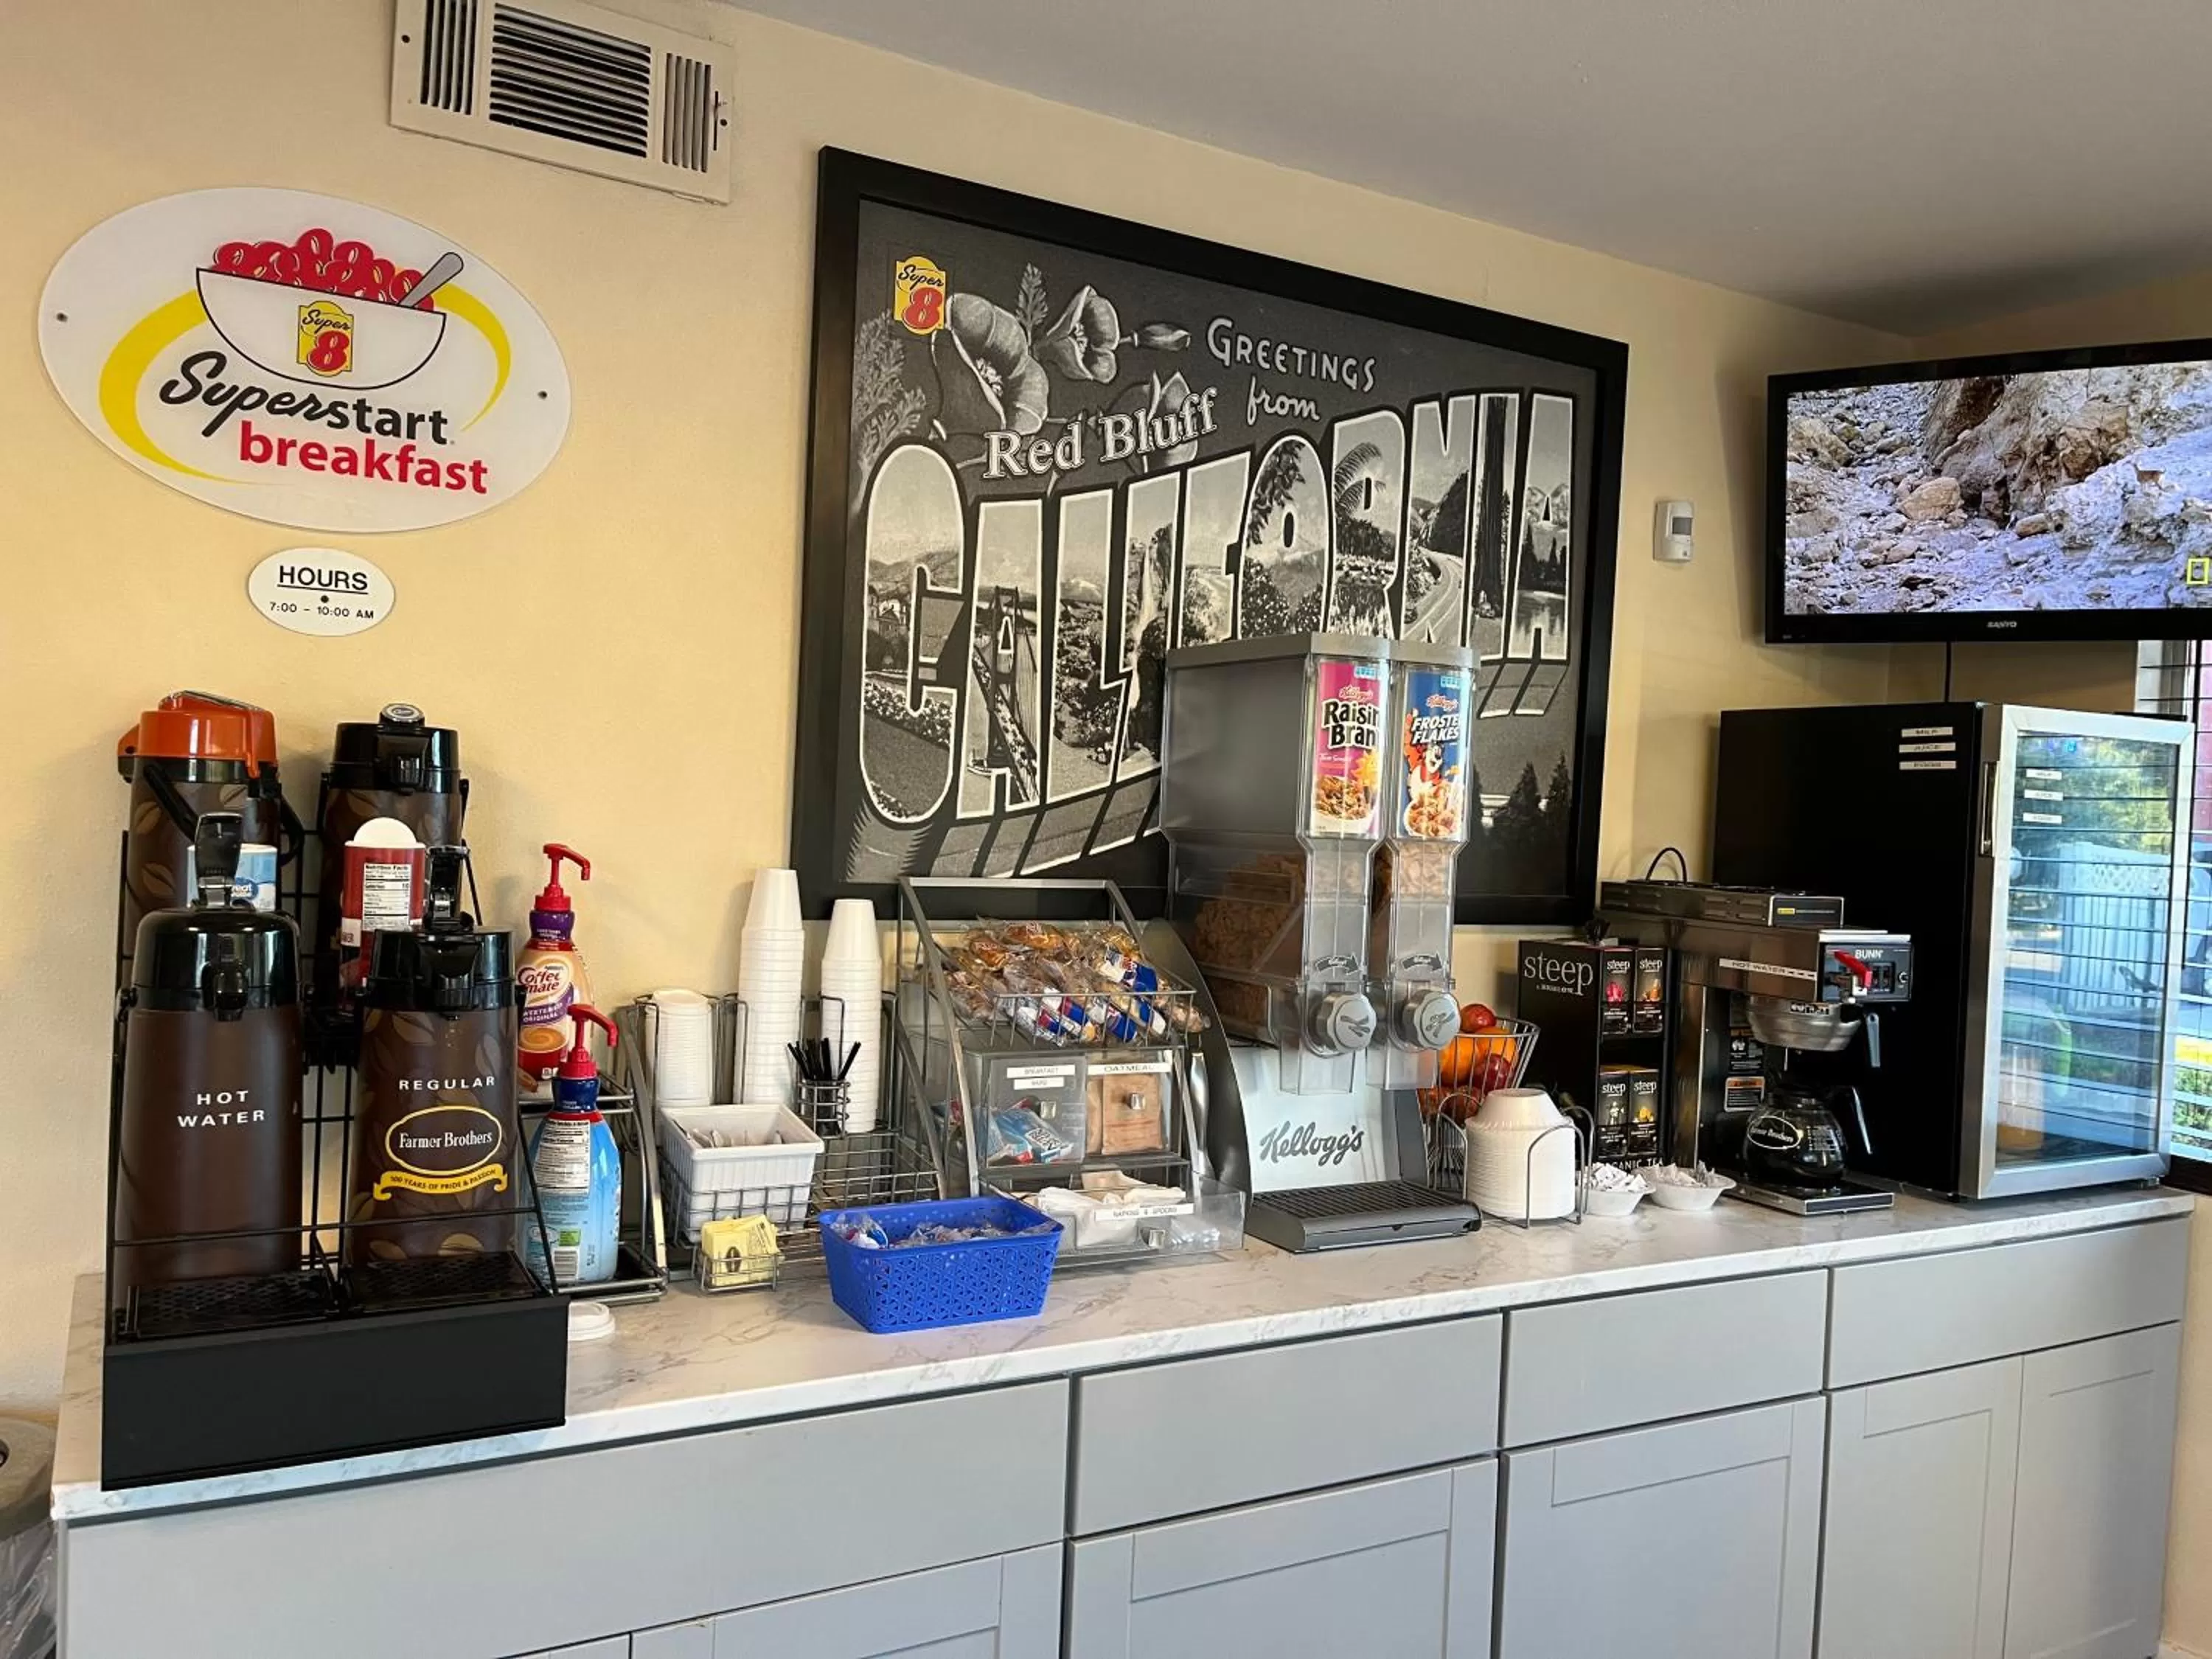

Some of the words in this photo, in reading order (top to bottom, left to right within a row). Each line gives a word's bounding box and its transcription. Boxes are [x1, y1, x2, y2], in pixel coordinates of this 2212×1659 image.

[898, 265, 944, 291] Super
[902, 287, 943, 329] 8
[302, 309, 351, 334] Super
[307, 330, 349, 372] 8
[1207, 316, 1377, 392] GREETINGS
[159, 350, 448, 445] Superstart
[1247, 375, 1321, 426] from
[983, 421, 1085, 479] Red
[1099, 386, 1219, 464] Bluff
[240, 420, 488, 494] breakfast
[279, 565, 368, 591] HOURS
[270, 602, 297, 613] 7:00
[317, 605, 350, 617] 10:00
[356, 610, 374, 619] AM
[859, 393, 1575, 824] CALIFORNIA
[1331, 723, 1377, 746] Bran
[1411, 714, 1460, 731] FROSTE
[1412, 727, 1459, 745] FLAKES
[1855, 948, 1884, 959] BUNN
[1524, 950, 1594, 996] steep
[399, 1076, 495, 1091] REGULAR
[196, 1091, 248, 1105] HOT
[177, 1110, 265, 1127] WATER
[399, 1131, 442, 1149] Farmer
[444, 1129, 493, 1147] Brothers
[1259, 1120, 1364, 1166] Kellogg's
